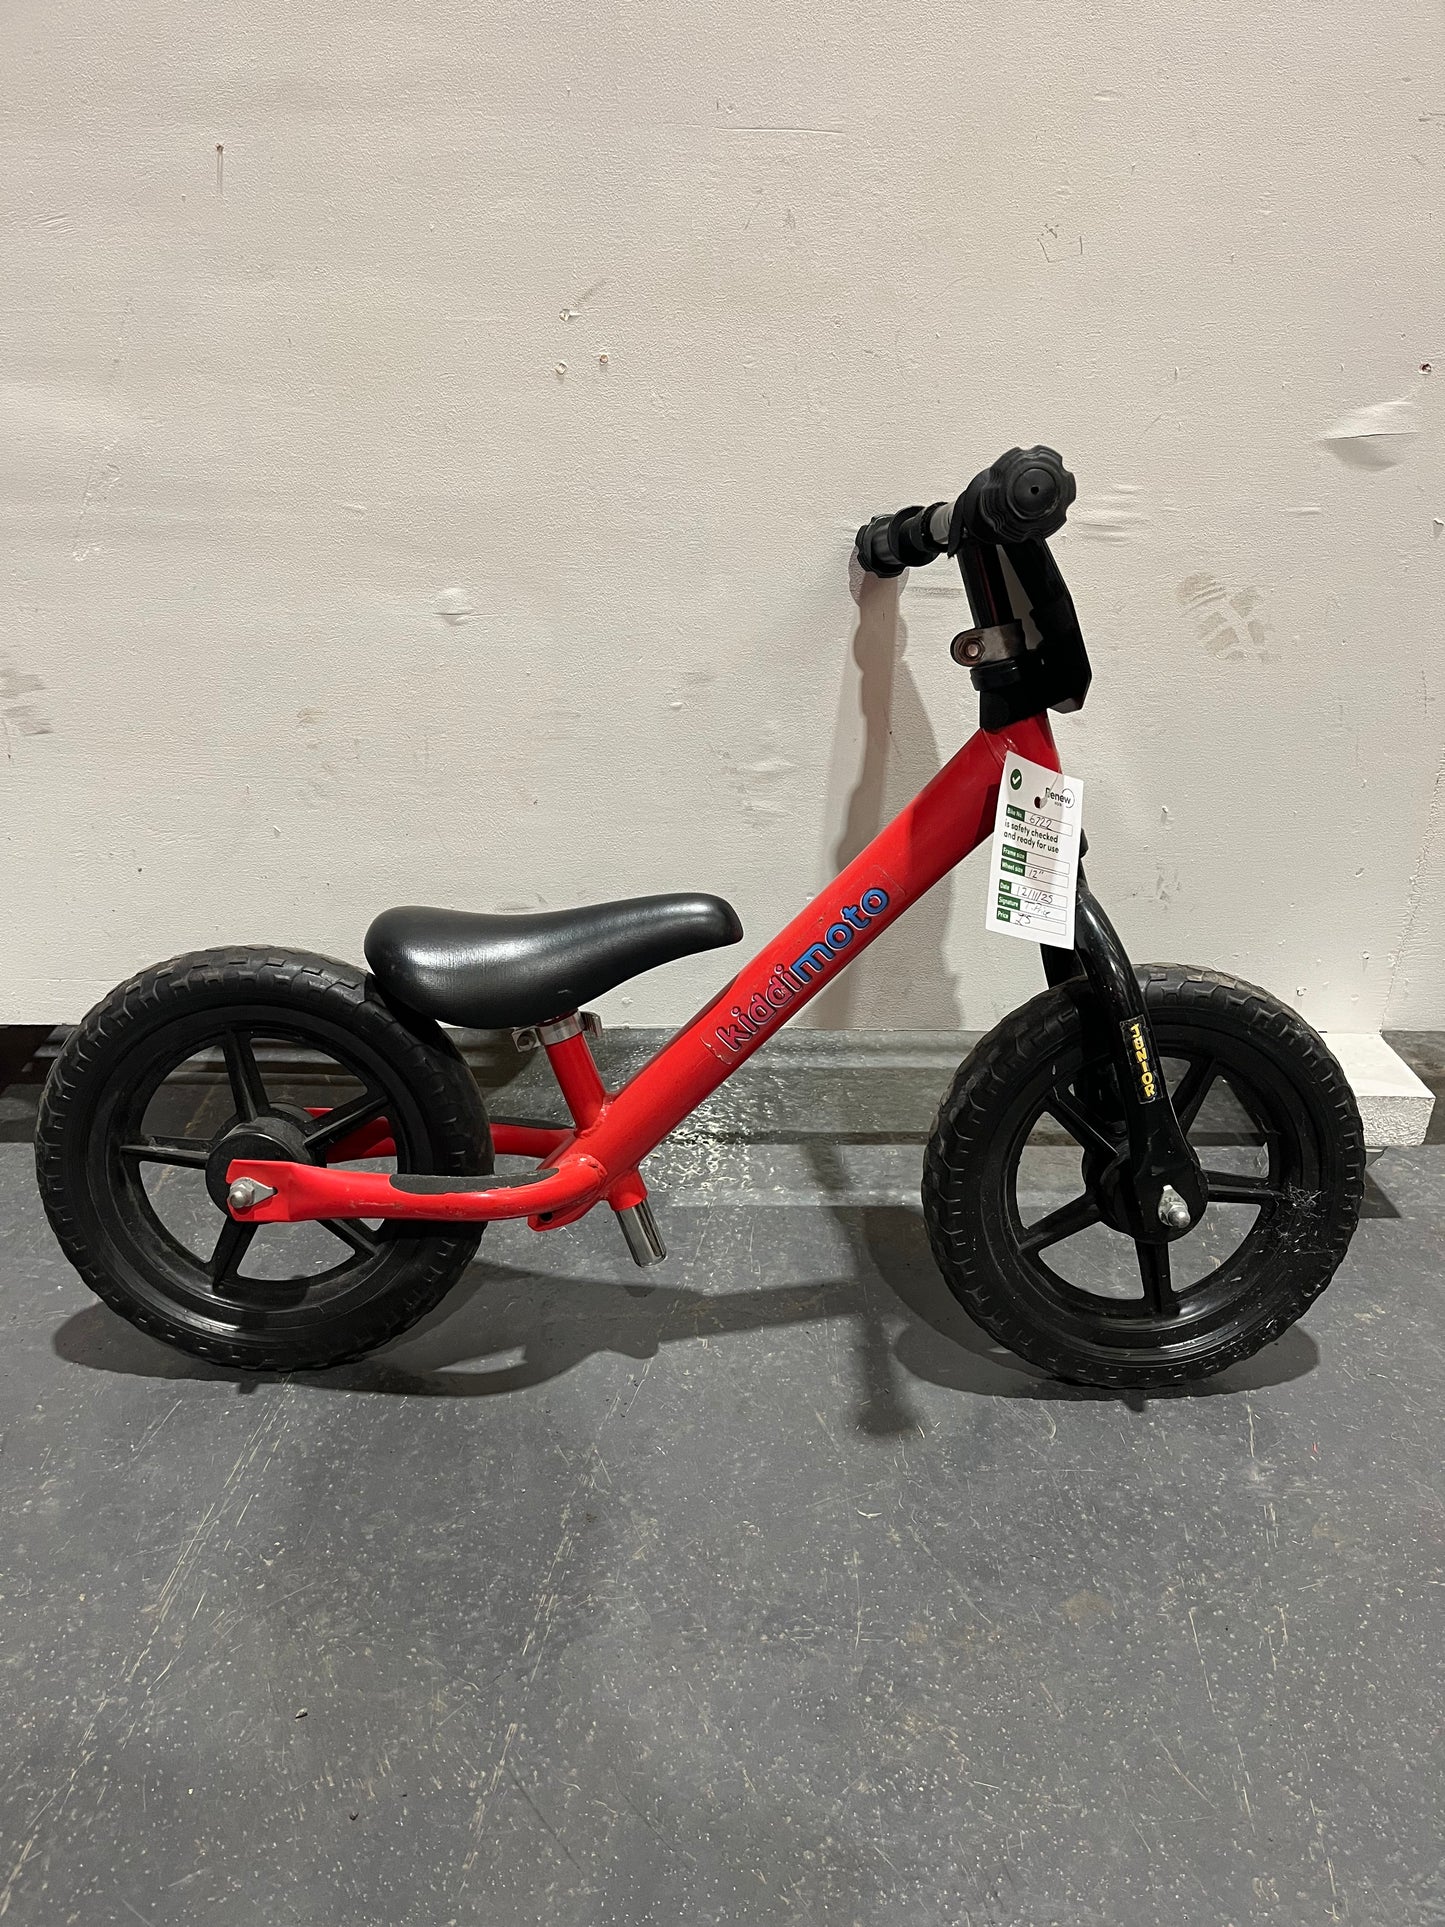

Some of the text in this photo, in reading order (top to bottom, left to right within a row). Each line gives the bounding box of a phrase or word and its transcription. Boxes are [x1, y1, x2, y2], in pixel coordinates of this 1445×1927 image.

[1045, 787, 1071, 804] Renew
[1004, 819, 1059, 843] is safety checked
[1003, 830, 1060, 854] and ready for use
[1002, 846, 1025, 860] Frame size
[1002, 861, 1024, 874] Wheel size
[999, 882, 1010, 891] Date
[998, 896, 1019, 908] Signature
[997, 910, 1009, 919] Price
[715, 887, 890, 1052] kiddimoto
[1130, 1023, 1155, 1097] JUNIOR
